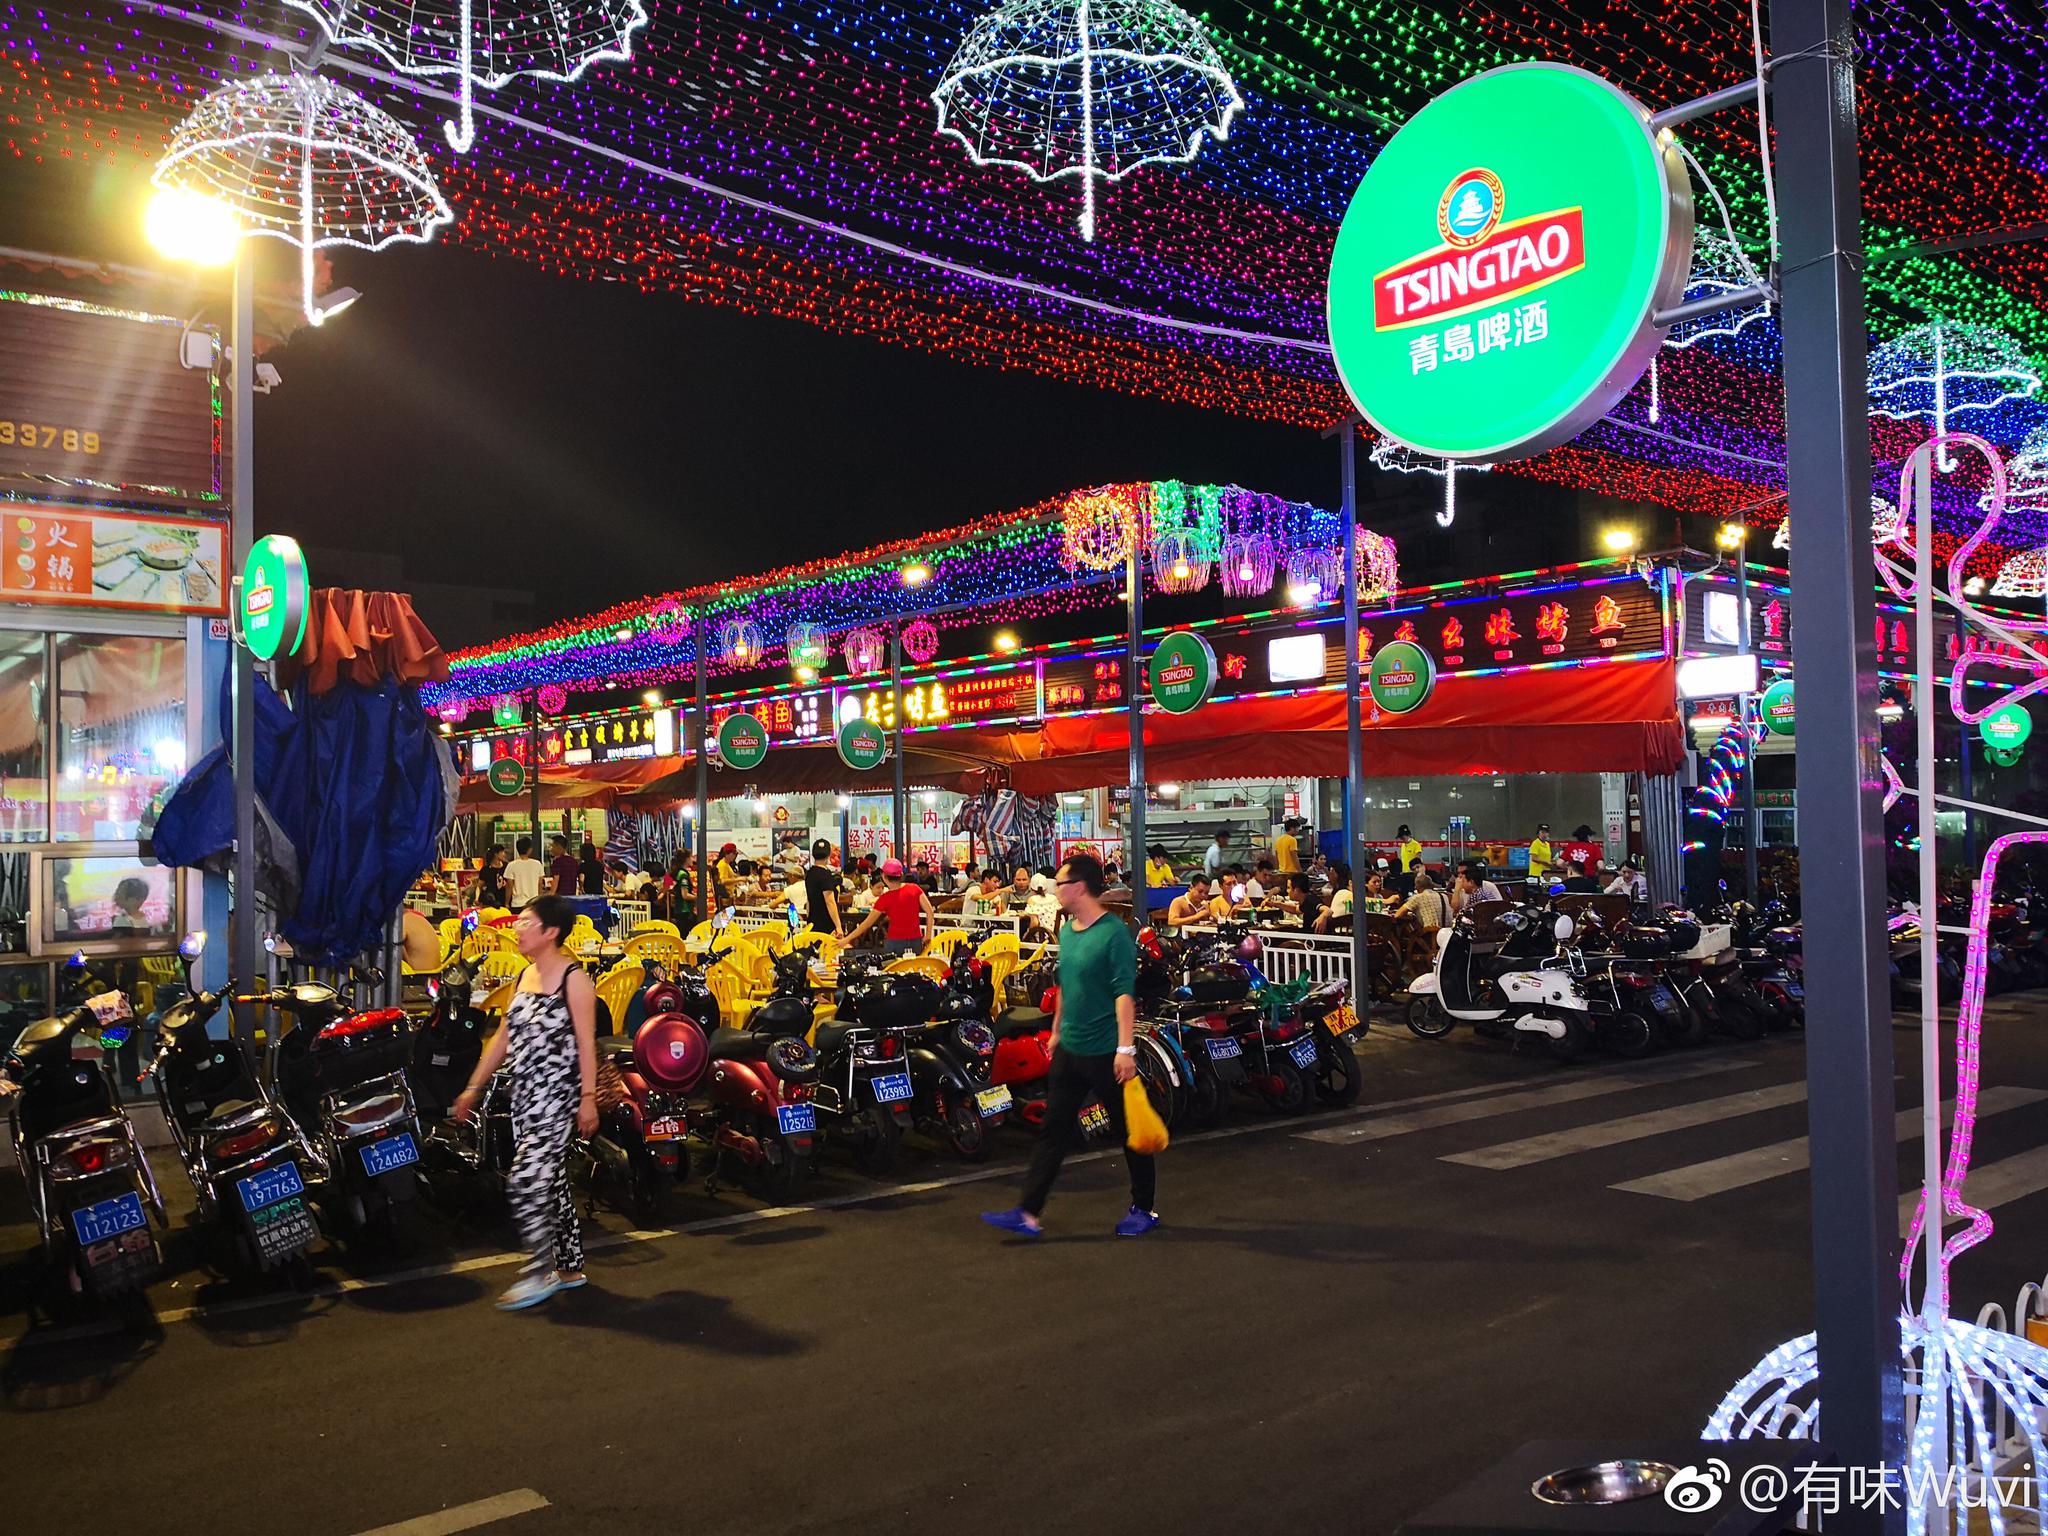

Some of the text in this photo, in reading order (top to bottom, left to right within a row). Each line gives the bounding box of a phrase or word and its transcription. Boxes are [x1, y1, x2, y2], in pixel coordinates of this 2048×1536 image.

[1385, 224, 1571, 316] TSINGTAO
[1408, 300, 1549, 376] 青島啤酒
[45, 520, 78, 581] 火锅
[1160, 669, 1194, 683] TSINGTAO
[1381, 673, 1415, 684] TSINGTAO
[1772, 705, 1796, 715] TSINGT
[731, 738, 760, 747] TSINGTAO
[852, 739, 878, 748] TSINGTAO
[848, 827, 892, 850] 经济实
[879, 1085, 911, 1101] 123987
[783, 1117, 814, 1131] 125215
[371, 1148, 414, 1172] 124482
[249, 1178, 298, 1207] 197763
[85, 1210, 140, 1239] 112123
